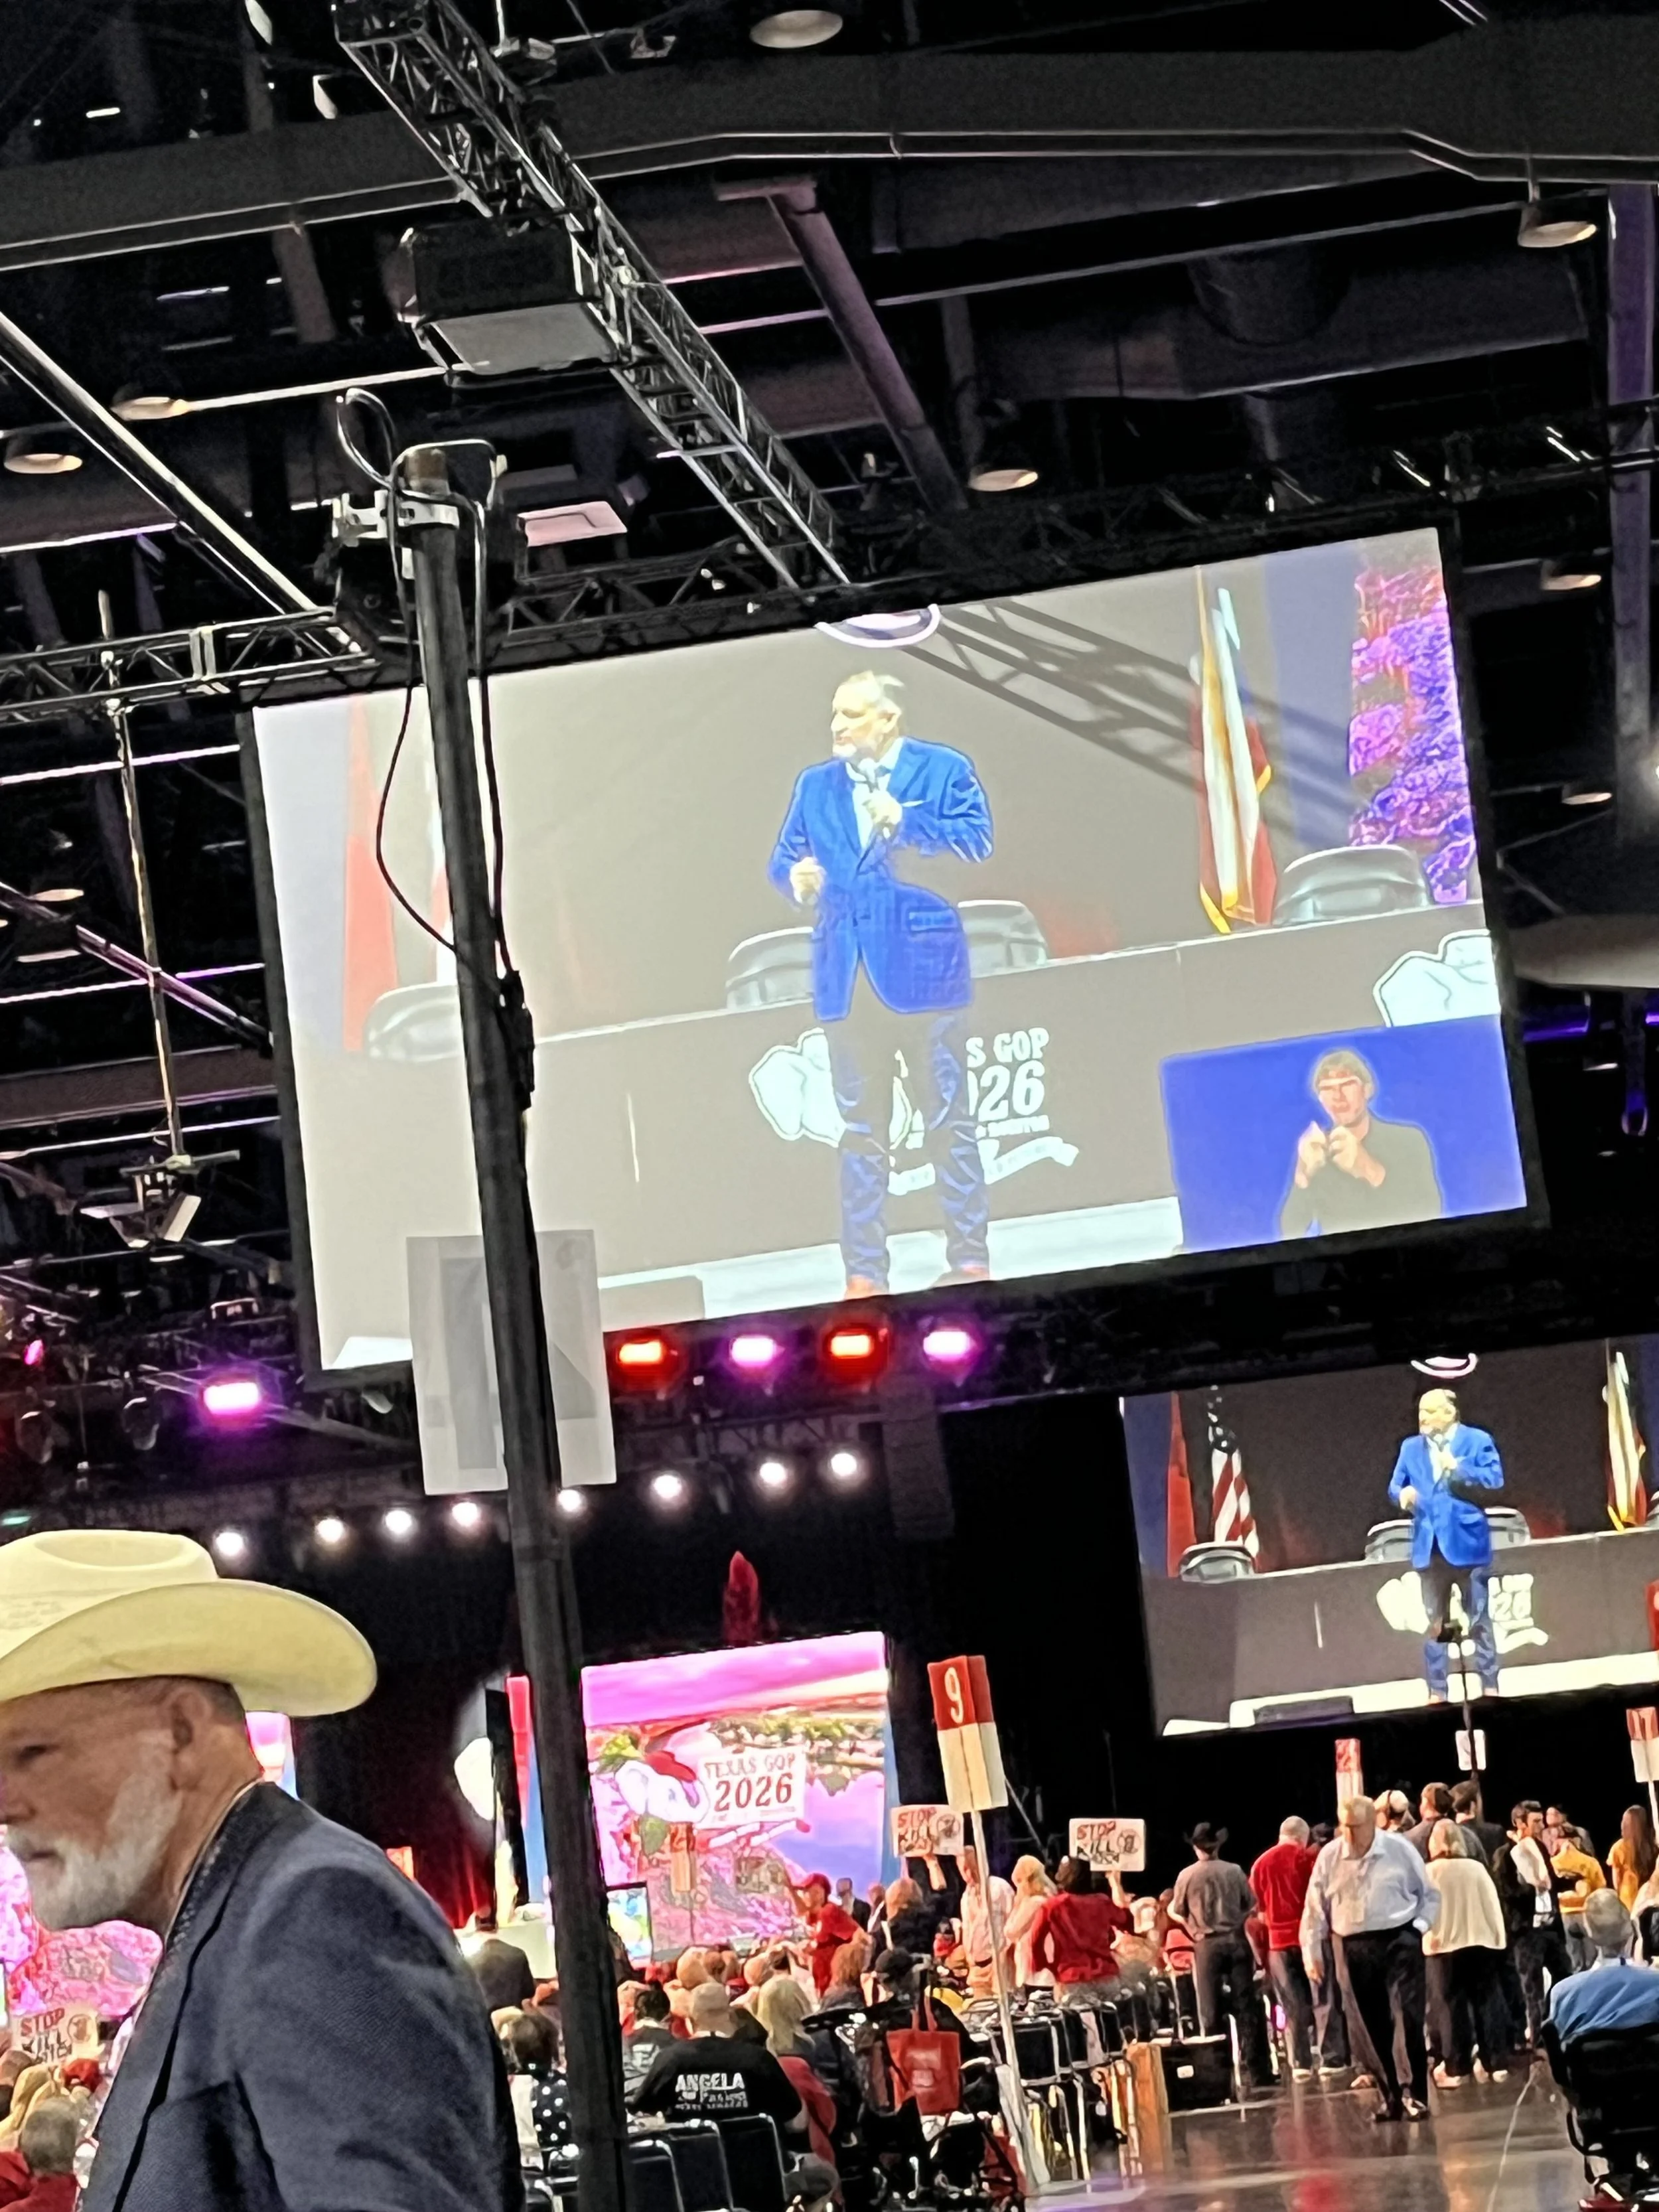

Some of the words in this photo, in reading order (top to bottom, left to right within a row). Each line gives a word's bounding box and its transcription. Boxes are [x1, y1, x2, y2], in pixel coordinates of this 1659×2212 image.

[993, 1027, 1049, 1063] GOP
[944, 1666, 964, 1724] 9
[704, 1757, 757, 1779] TEXAS
[764, 1753, 796, 1772] GOP
[714, 1772, 793, 1812] 2026
[21, 2008, 64, 2037] STOP
[675, 2073, 745, 2092] ANGELA
